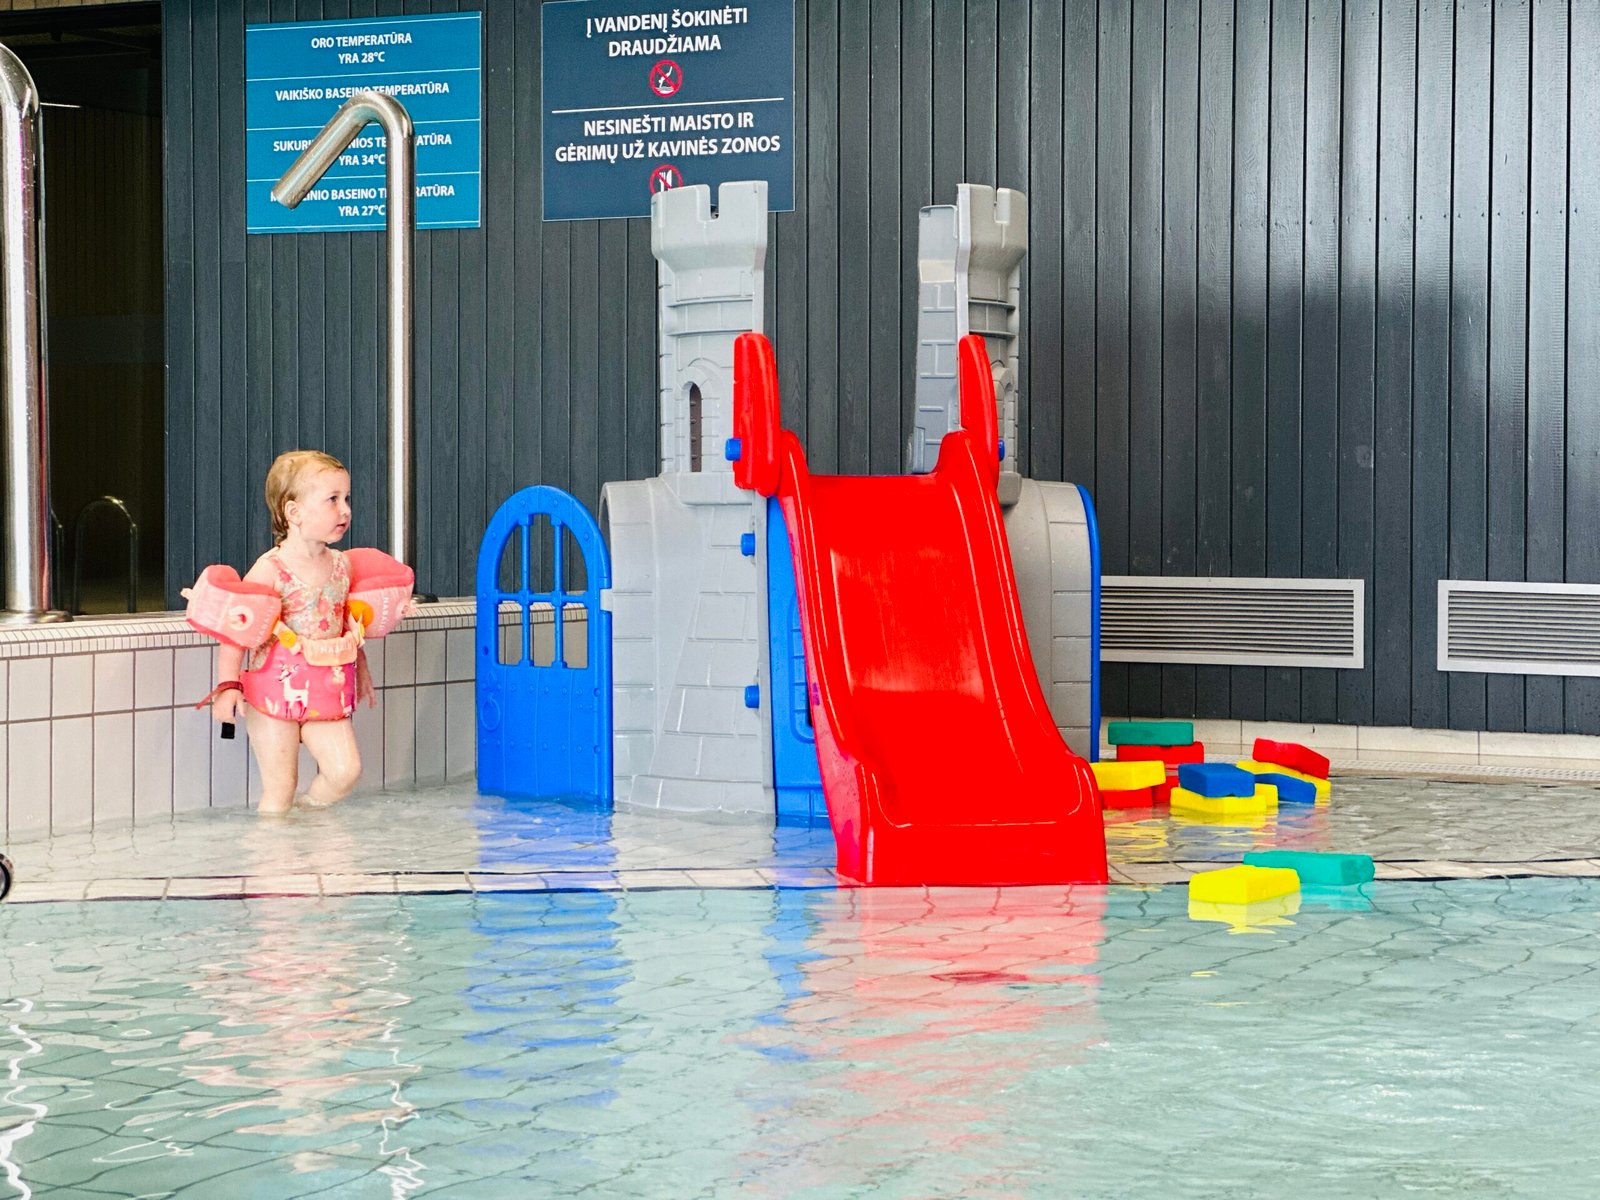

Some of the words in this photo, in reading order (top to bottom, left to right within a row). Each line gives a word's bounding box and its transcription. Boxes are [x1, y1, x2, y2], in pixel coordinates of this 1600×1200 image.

[586, 18, 592, 38] Į
[594, 13, 668, 33] VANDENĮ
[671, 6, 748, 28] ŠOKINĖTI
[311, 36, 335, 49] ORO
[336, 32, 413, 48] TEMPERATŪRA
[608, 34, 722, 57] DRAUDŽIAMA
[338, 53, 360, 64] YRA
[275, 87, 324, 101] VAIKIŠKO
[371, 82, 450, 97] TEMPERATŪRA
[584, 114, 666, 137] NESINEŠTI
[670, 113, 734, 132] MAISTO
[738, 112, 754, 128] IR
[374, 132, 452, 149] TEATŪRA
[555, 142, 619, 164] GĖRIMŲ
[622, 140, 645, 159] UŽ
[648, 136, 718, 158] KAVINĖS
[721, 136, 781, 154] ZONOS
[338, 154, 360, 166] YRA
[331, 187, 377, 201] BASEINO
[338, 205, 360, 217] YRA
